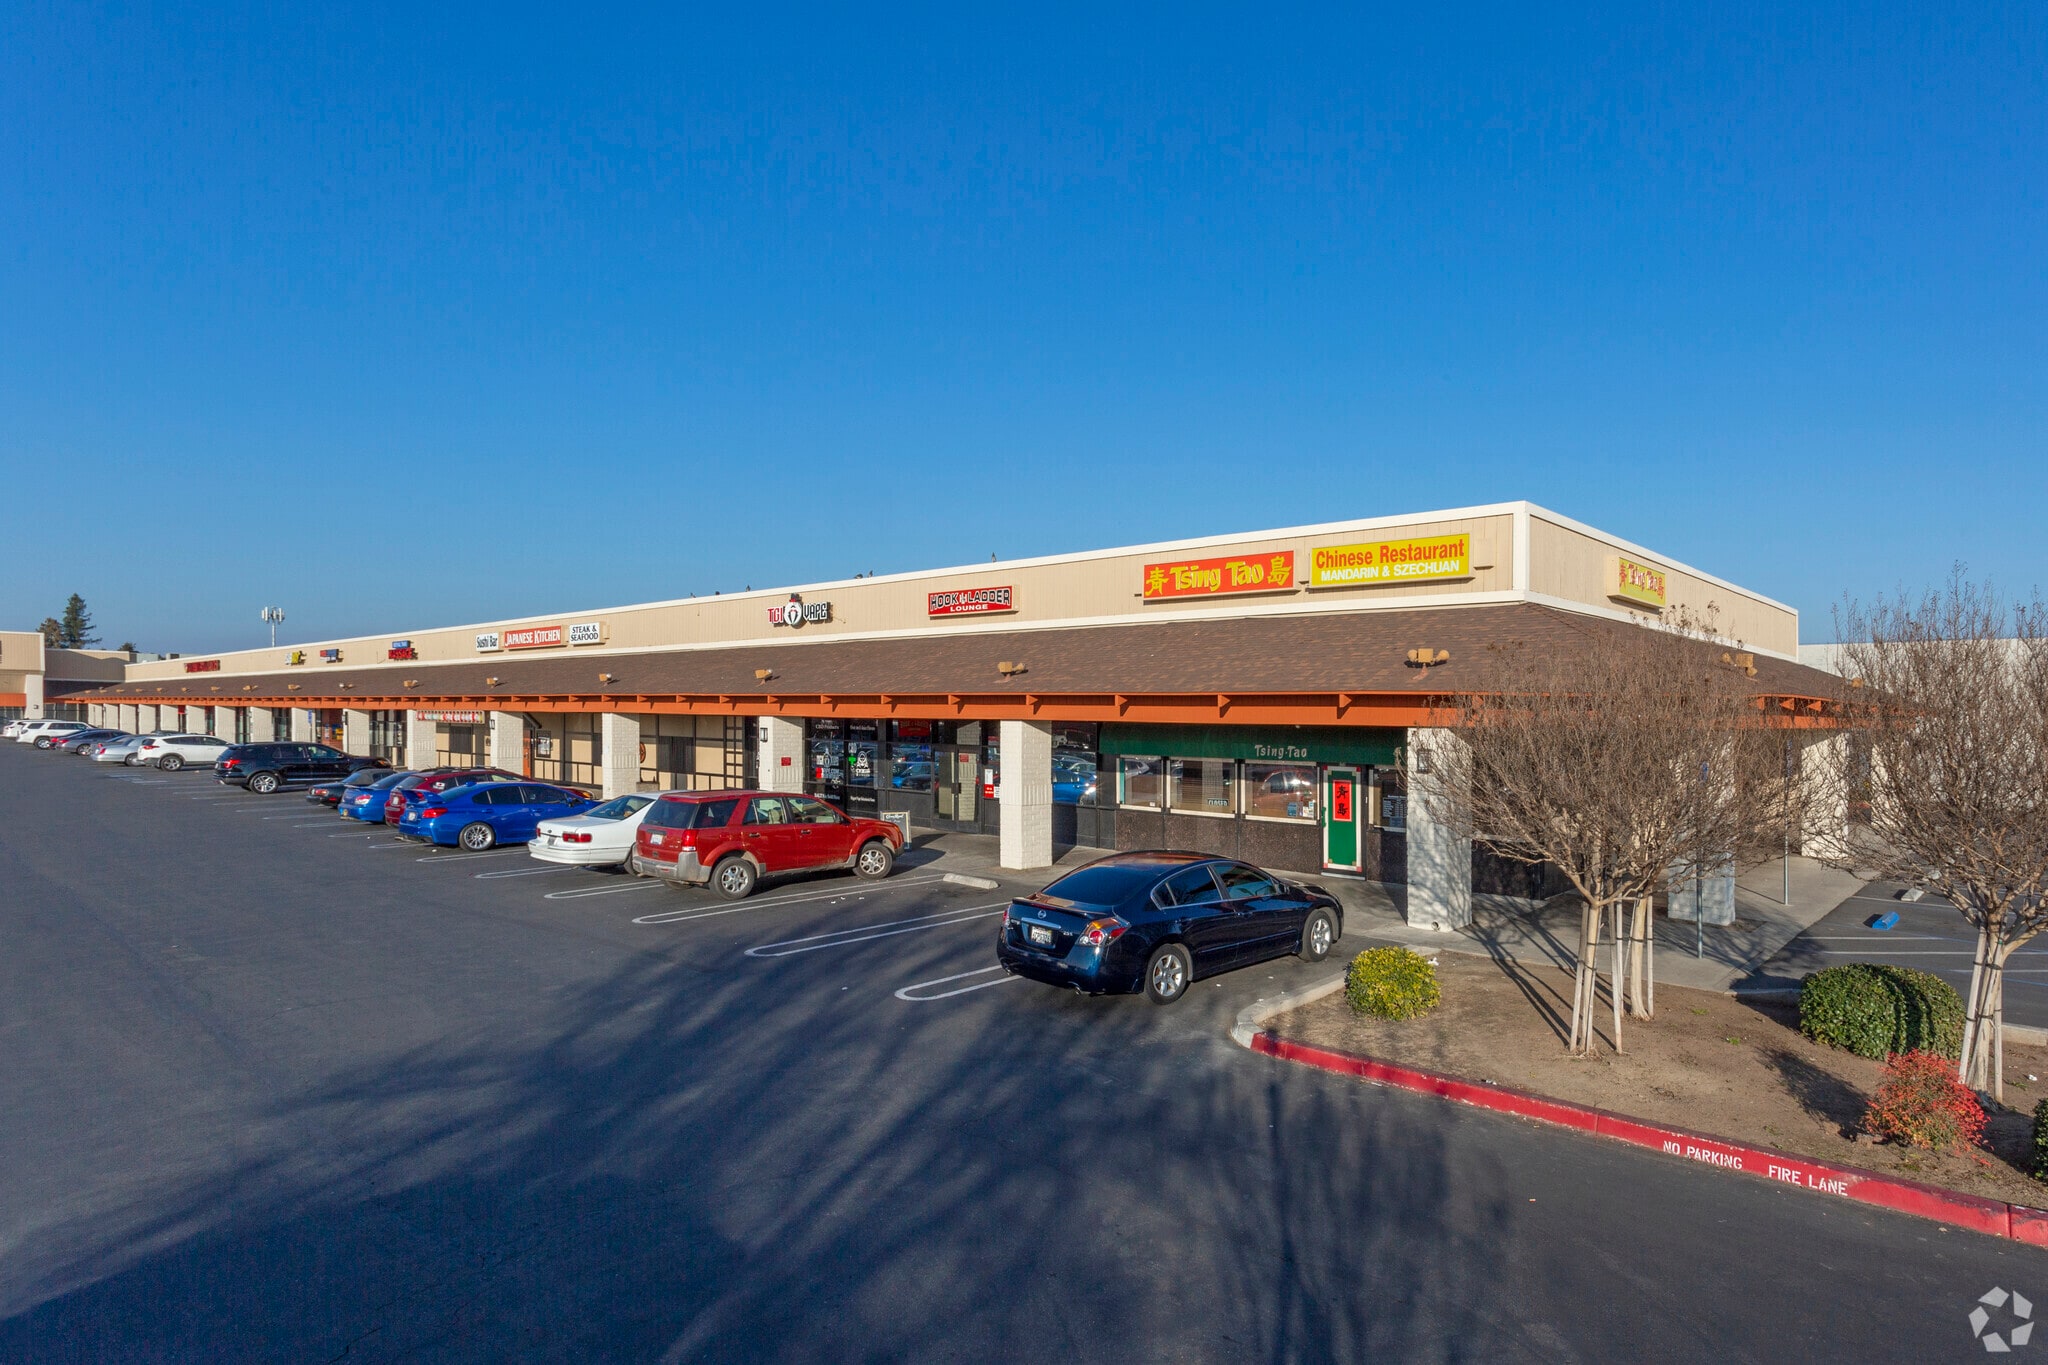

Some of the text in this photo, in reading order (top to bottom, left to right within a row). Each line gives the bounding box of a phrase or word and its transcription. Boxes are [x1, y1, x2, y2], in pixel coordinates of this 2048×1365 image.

[1316, 538, 1465, 569] Chinese Restaurant
[1145, 555, 1292, 596] 青 Tsing Tao 島
[1321, 560, 1460, 581] MANDARIN & SZECHUAN
[930, 588, 1011, 612] HOOK LADDER
[950, 604, 988, 612] LOUNGE
[767, 602, 828, 623] TGI VAPE
[505, 629, 561, 646] JAPANESE KITCHEN
[571, 632, 599, 641] SEAFOOD
[572, 625, 591, 634] STEAK
[476, 635, 498, 648] Sushi Bar
[1663, 1140, 1849, 1197] NO PARKING FIRE LANE
